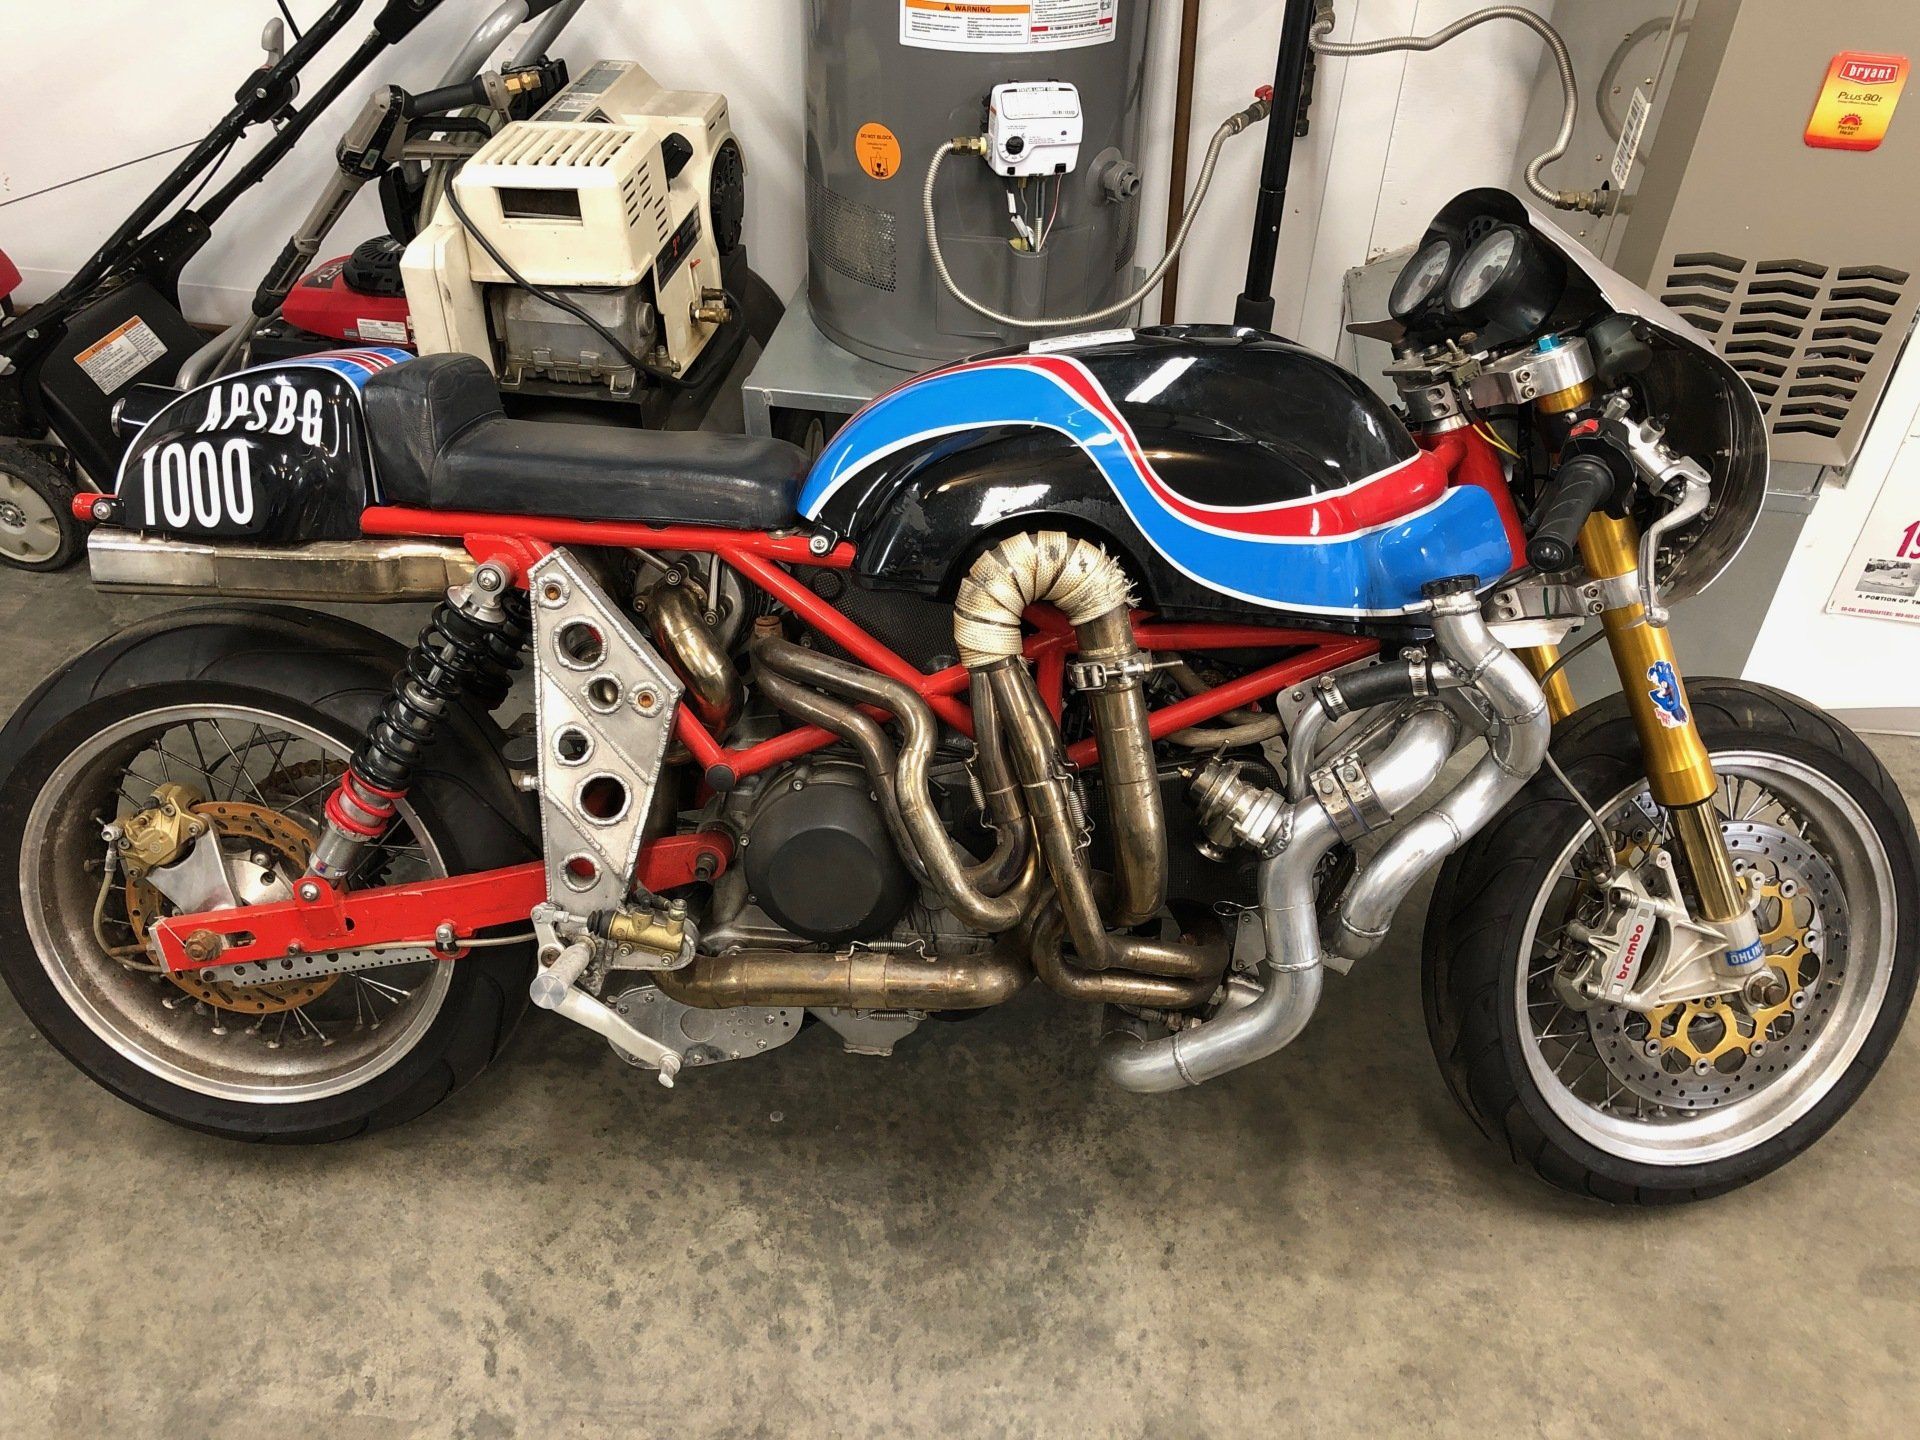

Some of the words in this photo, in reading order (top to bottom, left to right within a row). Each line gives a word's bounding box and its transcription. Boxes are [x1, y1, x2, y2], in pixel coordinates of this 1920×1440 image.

[954, 5, 991, 13] WARNING
[1849, 64, 1892, 80] bryant
[142, 437, 254, 529] 1000
[1865, 594, 1897, 603] PORTION
[1616, 924, 1644, 980] brembo
